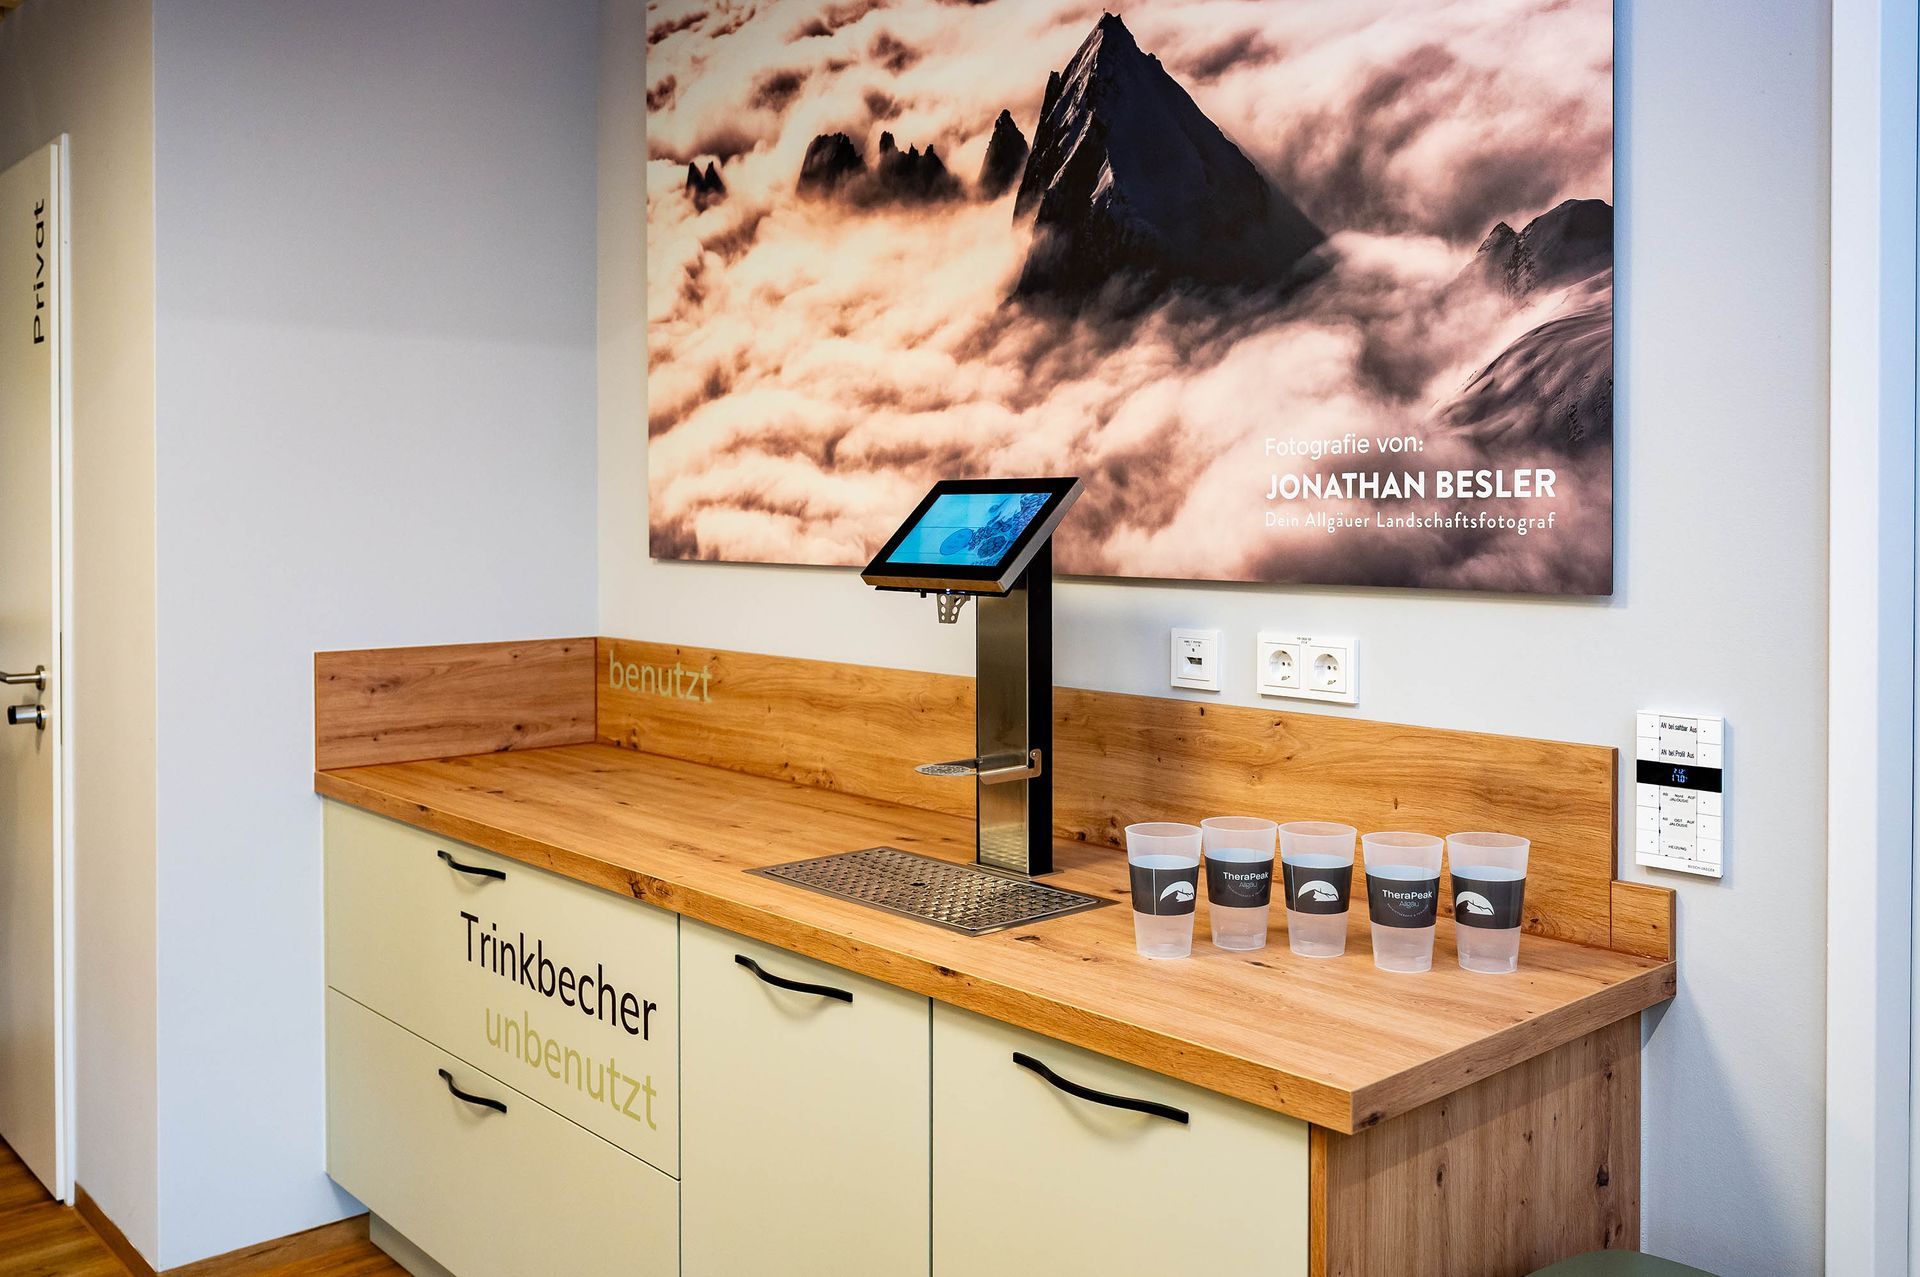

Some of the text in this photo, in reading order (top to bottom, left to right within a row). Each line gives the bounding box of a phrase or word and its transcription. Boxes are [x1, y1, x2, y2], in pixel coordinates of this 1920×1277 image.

[33, 198, 45, 345] Privat
[1265, 433, 1424, 460] Fotografie von:
[1266, 468, 1557, 500] JONATHAN BESLER
[1265, 511, 1556, 536] Dein Allgäuer Landschaftsfotograf
[609, 649, 712, 704] benutzt
[1222, 871, 1269, 882] TheraPeak
[1382, 889, 1433, 900] TheraPeak
[460, 910, 657, 1041] Trinkbecher
[485, 1007, 657, 1130] unbenutzt
